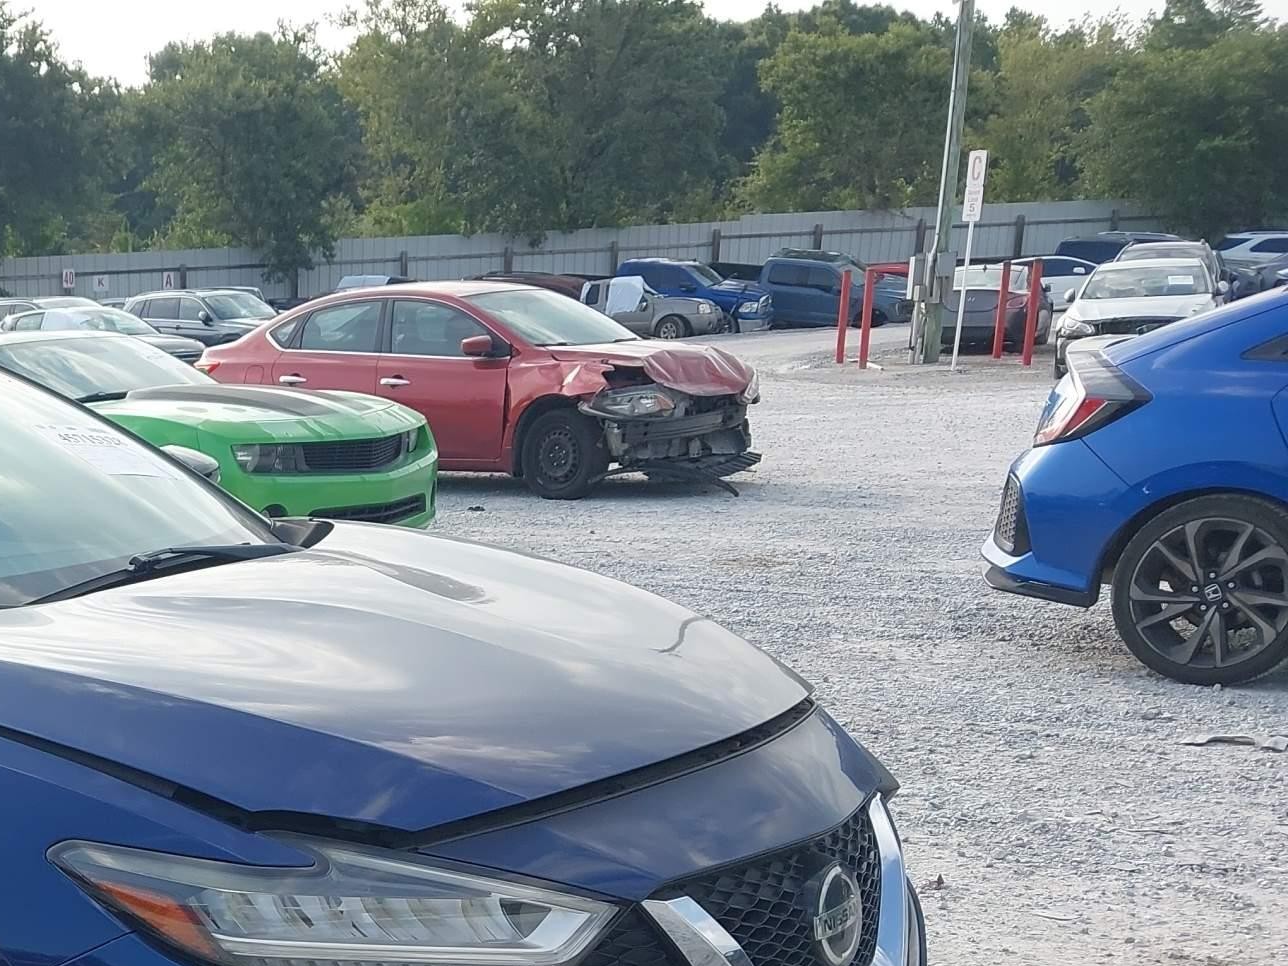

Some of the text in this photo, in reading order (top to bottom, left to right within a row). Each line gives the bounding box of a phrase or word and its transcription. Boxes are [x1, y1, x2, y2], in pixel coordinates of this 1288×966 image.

[969, 203, 975, 212] 5
[97, 278, 105, 288] K
[165, 273, 173, 288] A
